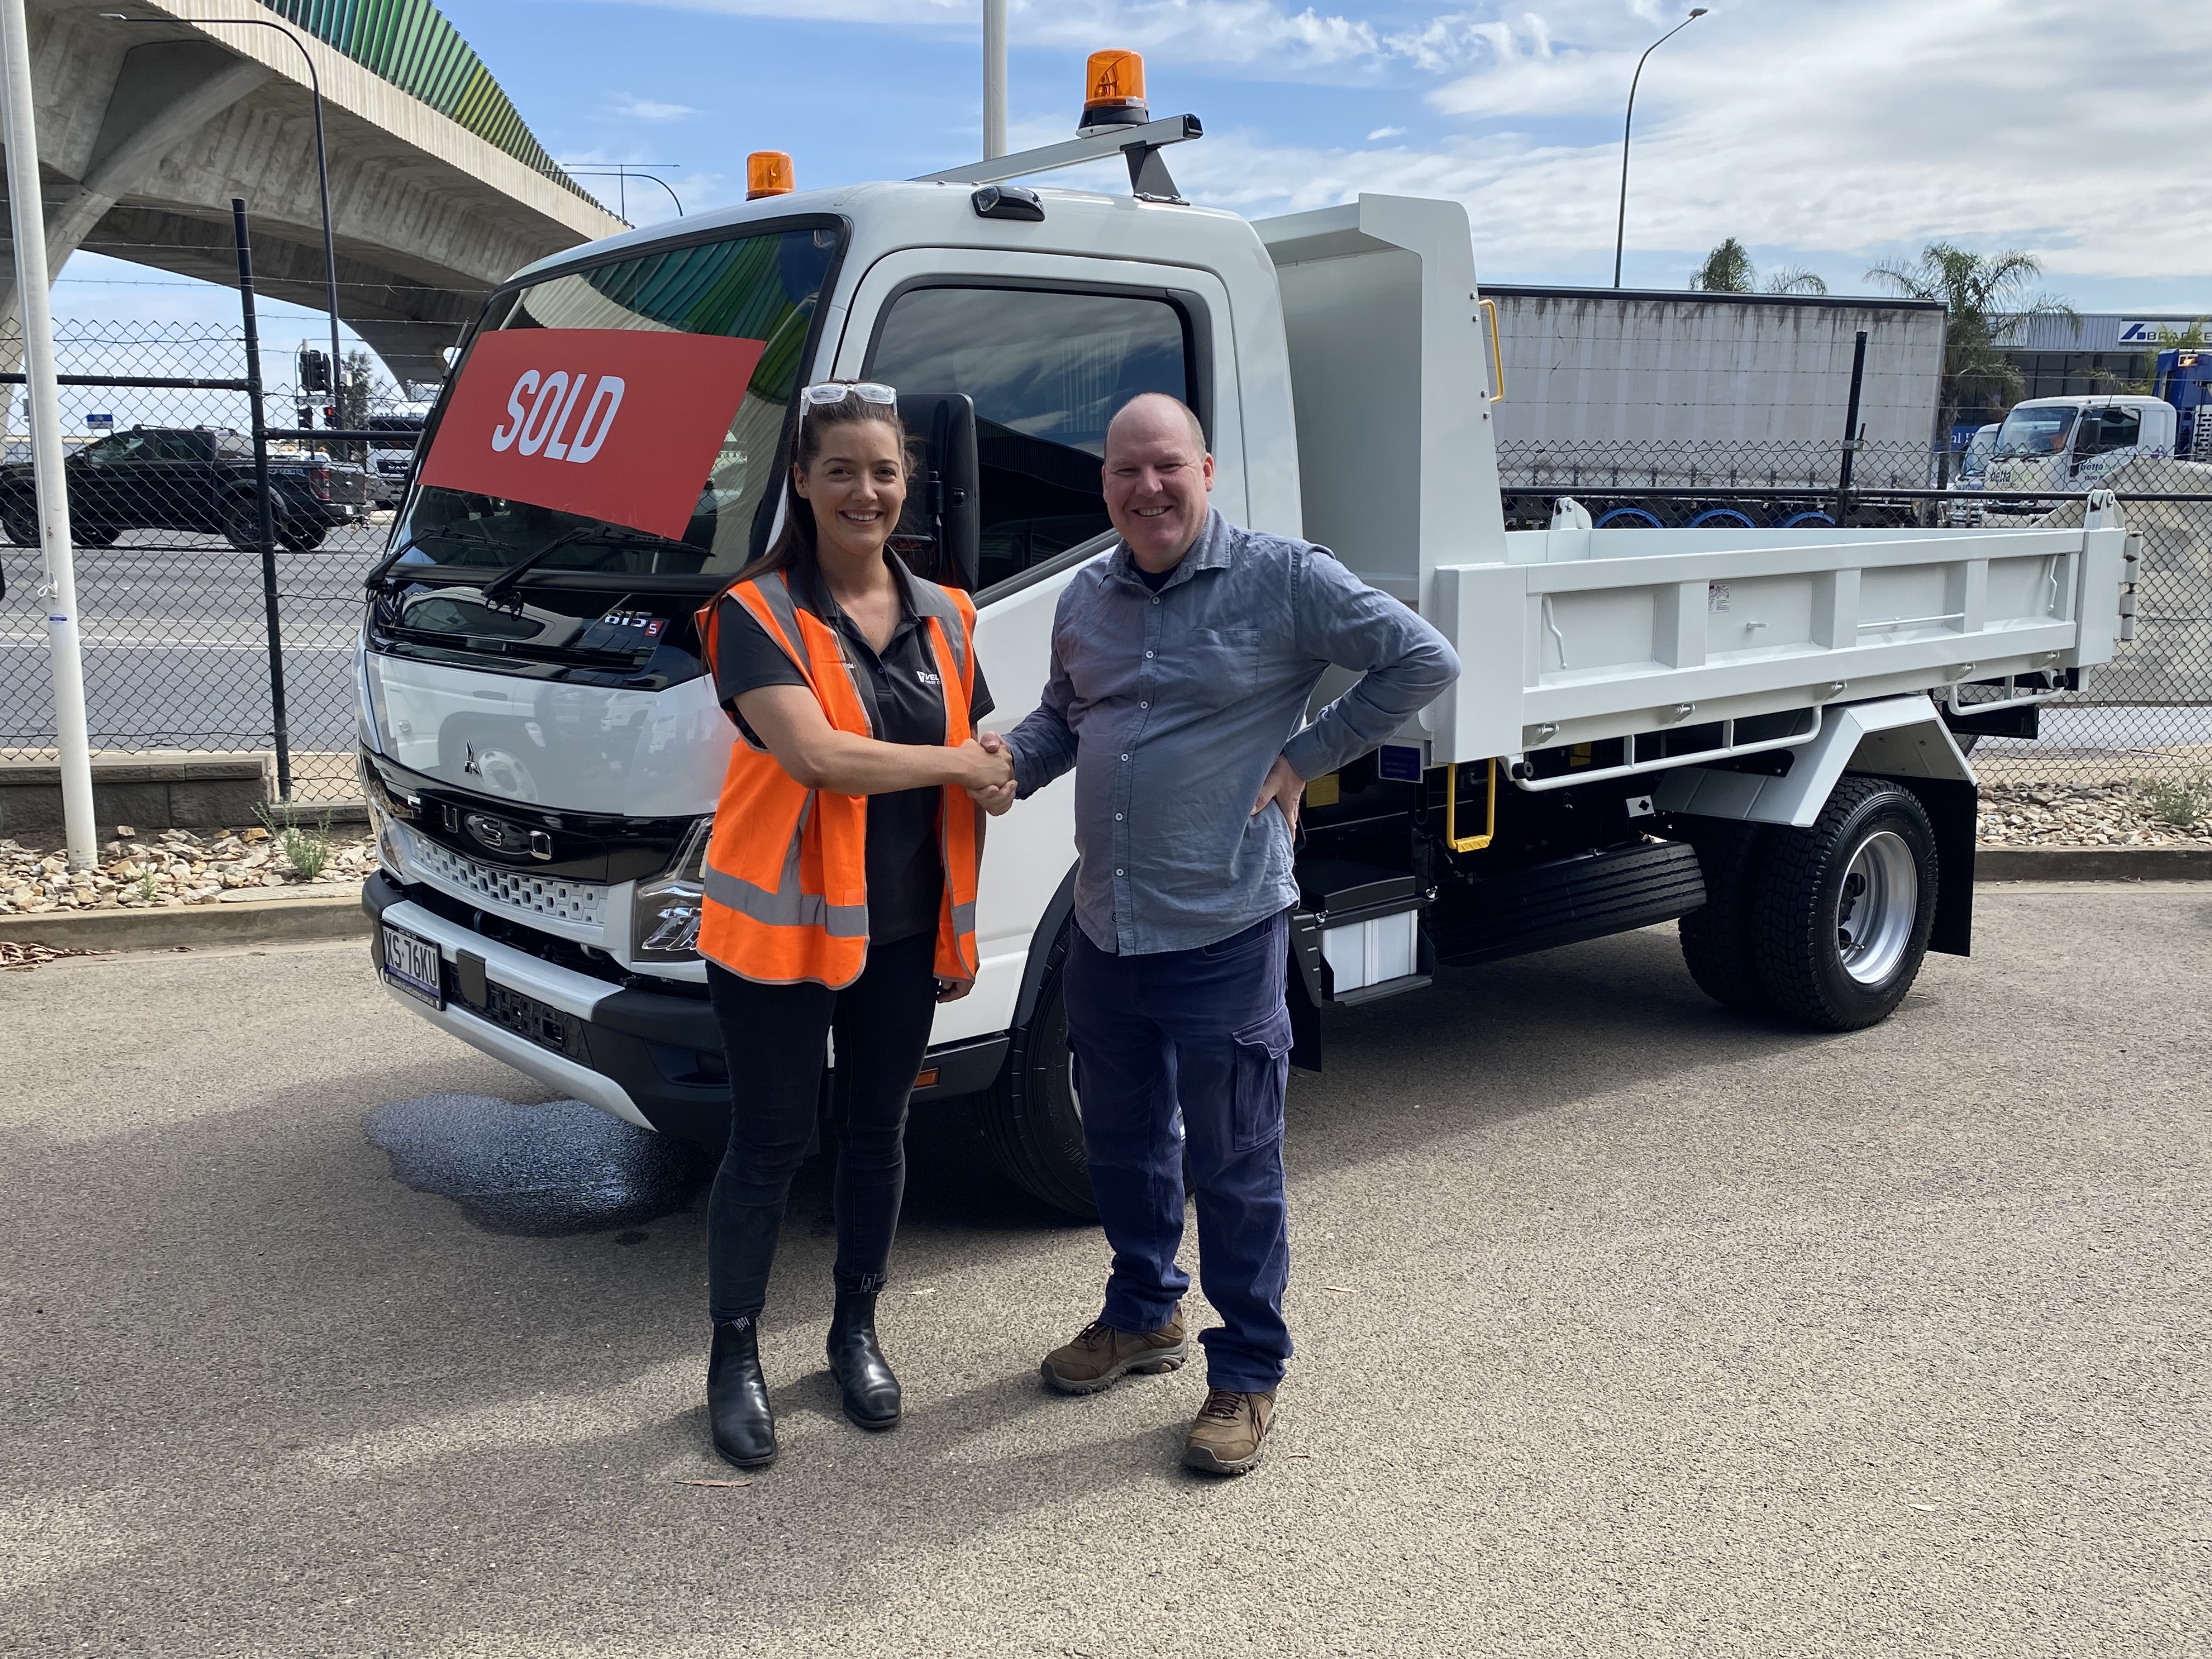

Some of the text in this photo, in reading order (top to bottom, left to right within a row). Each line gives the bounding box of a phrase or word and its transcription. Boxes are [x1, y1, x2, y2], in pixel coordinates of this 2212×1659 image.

[492, 369, 625, 463] SOLD
[605, 610, 657, 634] 815 S
[407, 795, 552, 860] FUSO
